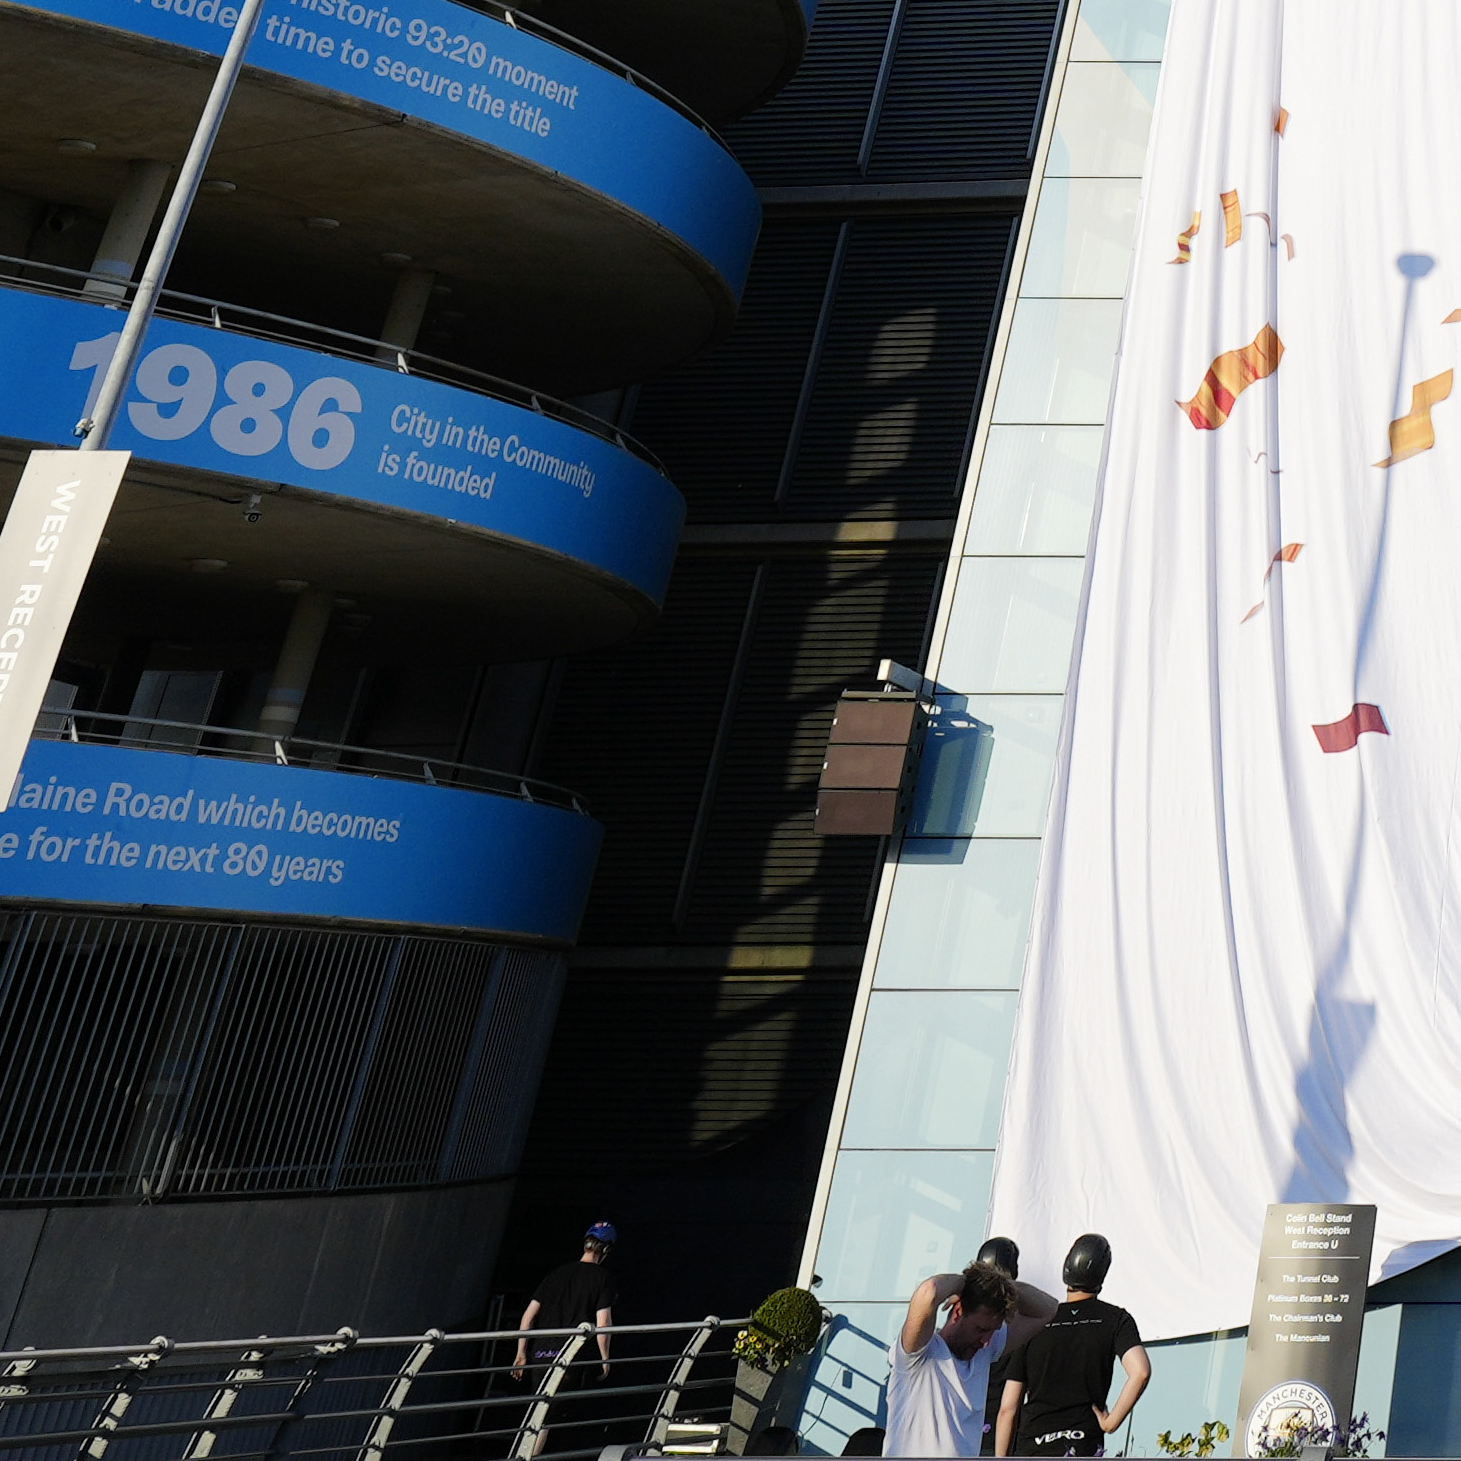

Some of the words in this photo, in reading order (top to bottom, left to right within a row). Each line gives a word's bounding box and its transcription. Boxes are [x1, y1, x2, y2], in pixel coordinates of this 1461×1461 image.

[265, 14, 334, 58] time
[341, 39, 369, 69] to
[374, 55, 463, 103] secure
[466, 82, 505, 119] the
[509, 100, 551, 138] title
[406, 19, 487, 69] 93:20
[489, 55, 579, 111] moment
[67, 330, 363, 471] 1986
[377, 444, 400, 476] is
[403, 451, 497, 500] founded
[390, 404, 441, 448] City
[442, 417, 464, 448] in
[467, 425, 501, 458] the
[502, 435, 597, 498] Community
[28, 479, 81, 574] WEST
[9, 773, 97, 813] aine
[103, 782, 194, 822] Road
[198, 794, 288, 832] which
[289, 800, 402, 844] becomes
[26, 826, 81, 863] for
[85, 831, 141, 868] the
[144, 842, 220, 875] next
[223, 842, 269, 877] 80
[269, 853, 345, 887] years
[1284, 1226, 1305, 1235] West
[1307, 1226, 1351, 1236] Reception
[1286, 1213, 1307, 1223] Colin
[1308, 1213, 1325, 1223] Bell
[1326, 1213, 1352, 1223] Stand
[1292, 1240, 1329, 1249] Entrance
[1330, 1239, 1339, 1250] U
[1282, 1275, 1295, 1283] The
[1321, 1275, 1339, 1283] Club
[1325, 1314, 1342, 1322] Club
[1257, 1388, 1328, 1422] MANCHESTER
